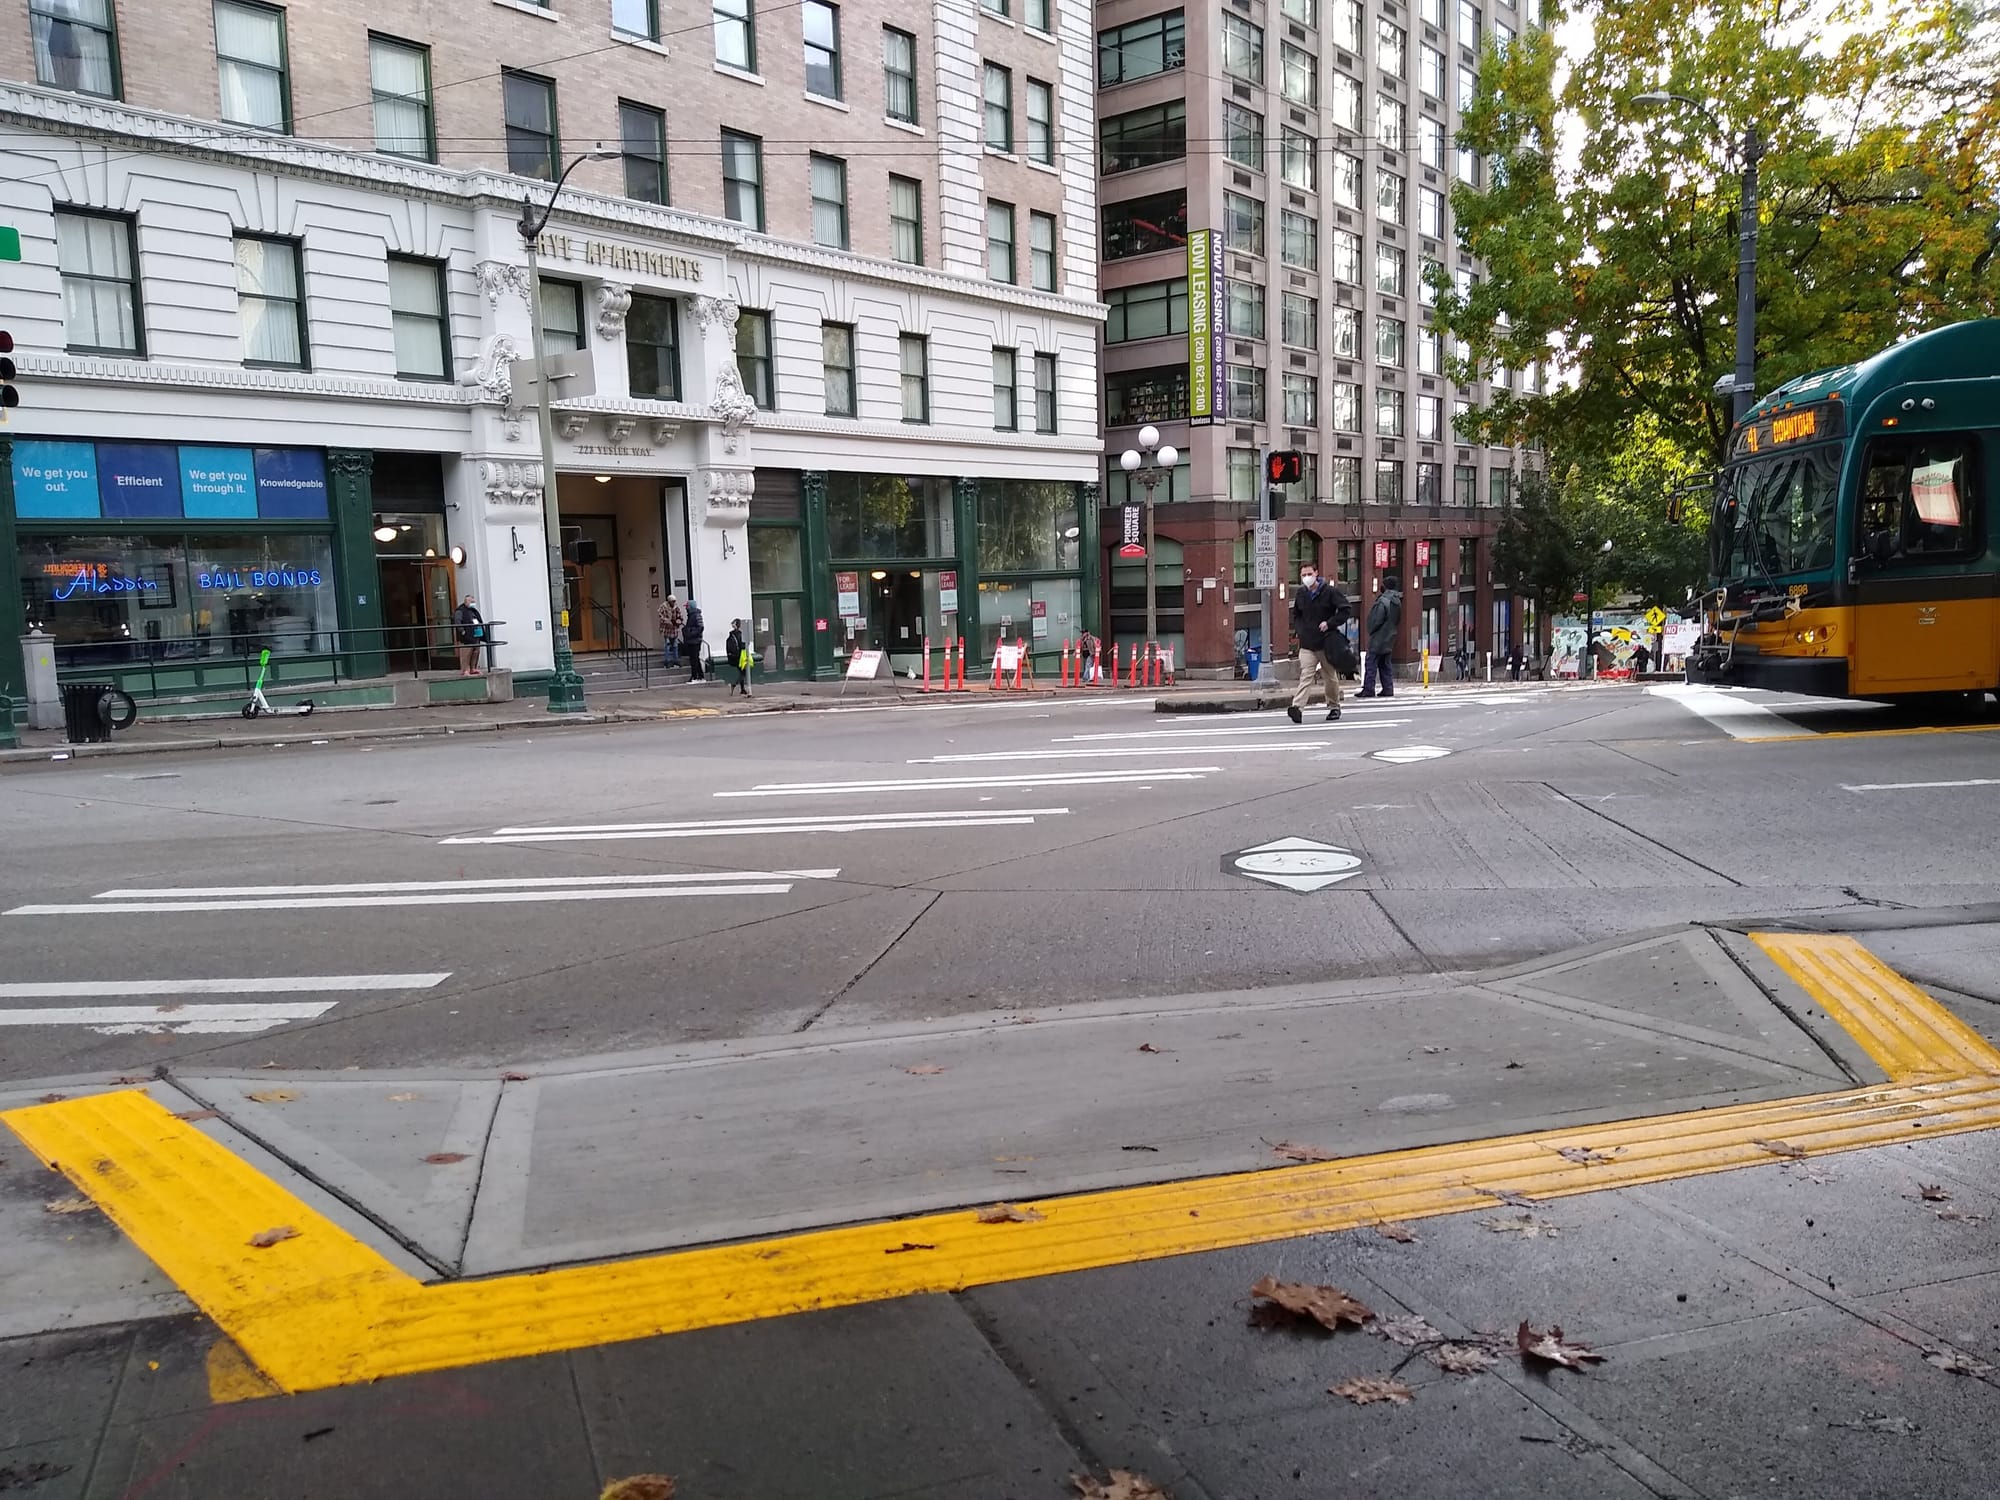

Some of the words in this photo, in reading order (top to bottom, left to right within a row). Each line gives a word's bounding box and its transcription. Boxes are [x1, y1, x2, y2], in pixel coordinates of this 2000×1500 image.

[585, 240, 703, 282] APARTMENTS
[1191, 233, 1206, 269] NOW
[1213, 233, 1222, 270] NOW
[1192, 272, 1207, 334] LEASING
[1213, 272, 1223, 333] LEASING
[1193, 336, 1206, 363] (206)
[1214, 336, 1223, 363] (206)
[1195, 365, 1206, 411] 621-2100
[1215, 364, 1223, 411] 621-2100
[1772, 410, 1816, 444] DOWNTOWN
[631, 446, 652, 457] WAY
[21, 466, 42, 478] We
[44, 468, 63, 480] get
[66, 469, 89, 480] you
[116, 475, 164, 487] Efficient
[189, 470, 206, 480] We
[208, 471, 226, 481] get
[228, 472, 248, 482] you
[259, 478, 324, 490] Knowledgeable
[45, 482, 69, 492] out.
[192, 483, 234, 495] through
[236, 484, 247, 493] it.
[1124, 506, 1132, 544] PIONEER
[1132, 506, 1140, 543] SQUARE
[1351, 523, 1474, 537] QUINTESSA
[55, 568, 158, 600] Aladdin
[200, 572, 245, 588] BAIL
[254, 570, 321, 586] BONDS
[839, 582, 856, 590] LEASE
[1665, 626, 1677, 634] NO
